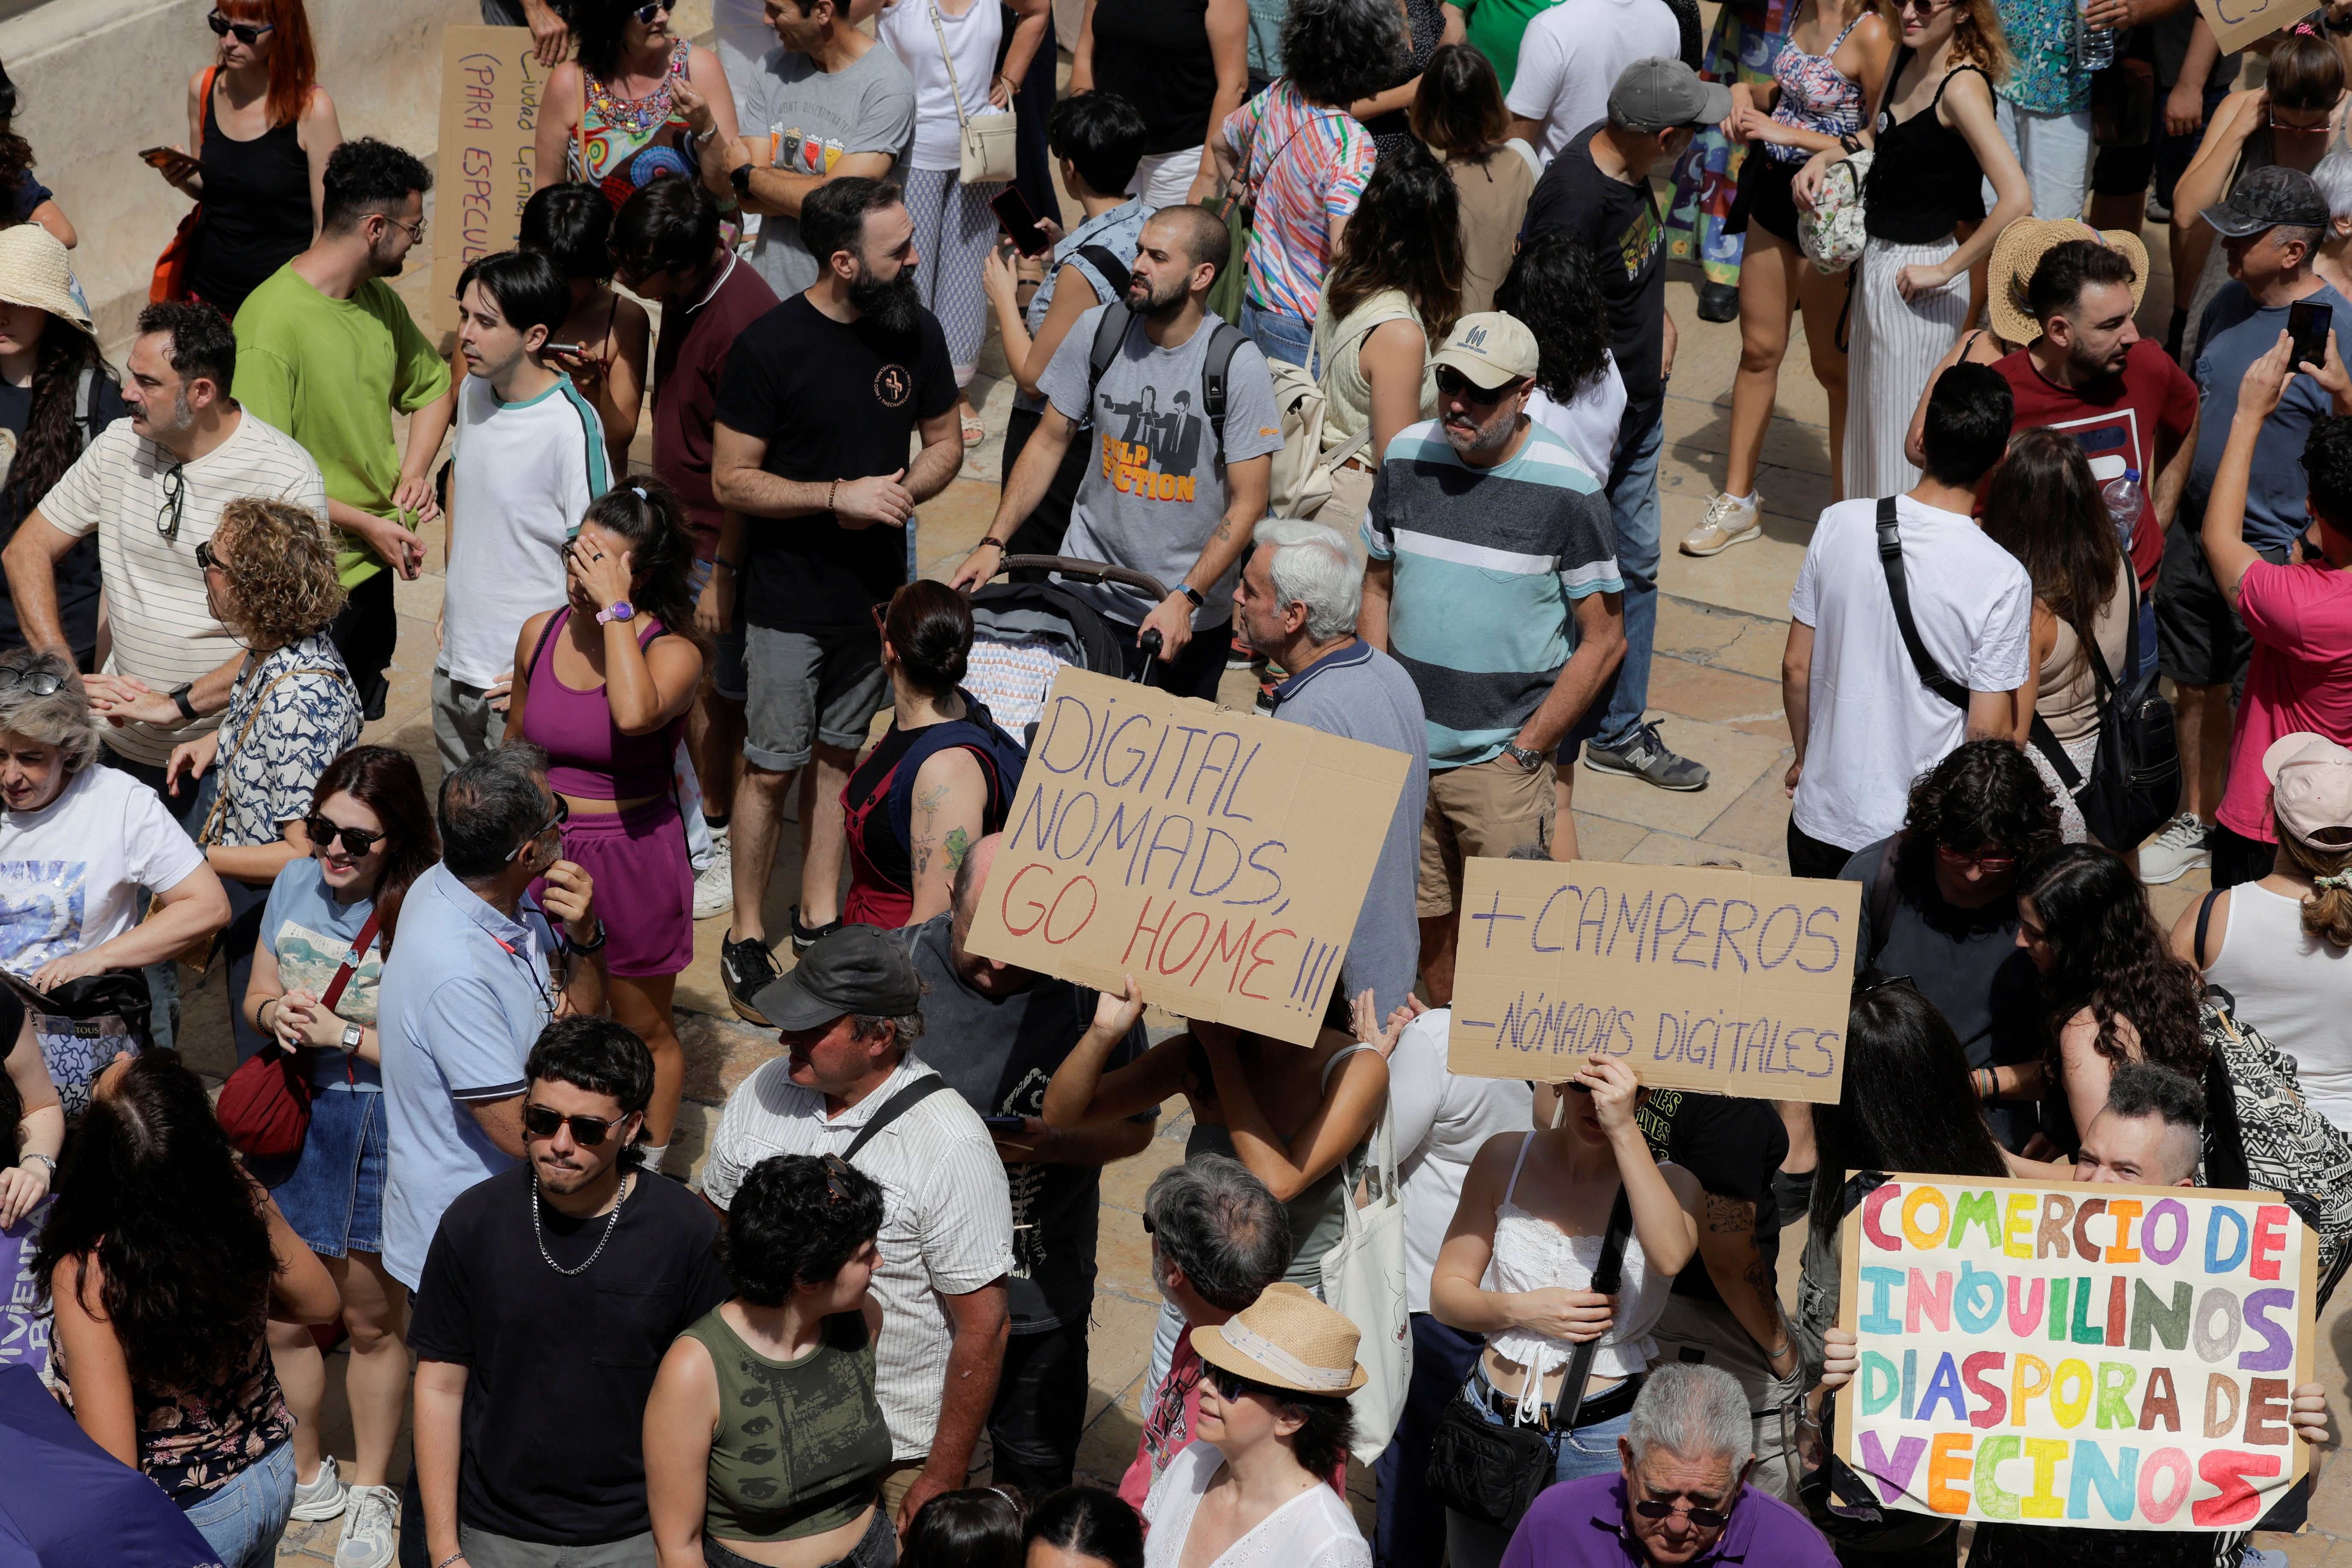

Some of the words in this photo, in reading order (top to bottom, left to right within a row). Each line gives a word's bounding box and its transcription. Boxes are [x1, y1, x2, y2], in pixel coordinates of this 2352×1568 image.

[1102, 433, 1149, 468] PULP
[1102, 454, 1197, 503] FICTION
[1010, 783, 1291, 916] NOMADS,
[1002, 863, 1098, 945] GO
[1862, 1184, 2189, 1266] COMERCIO
[2203, 1205, 2290, 1281] DE
[1859, 1260, 2295, 1373] INQUILINOS
[1861, 1350, 2181, 1433] DIASPORA
[2203, 1372, 2289, 1446] DE
[1857, 1429, 2281, 1527] VECINOS
